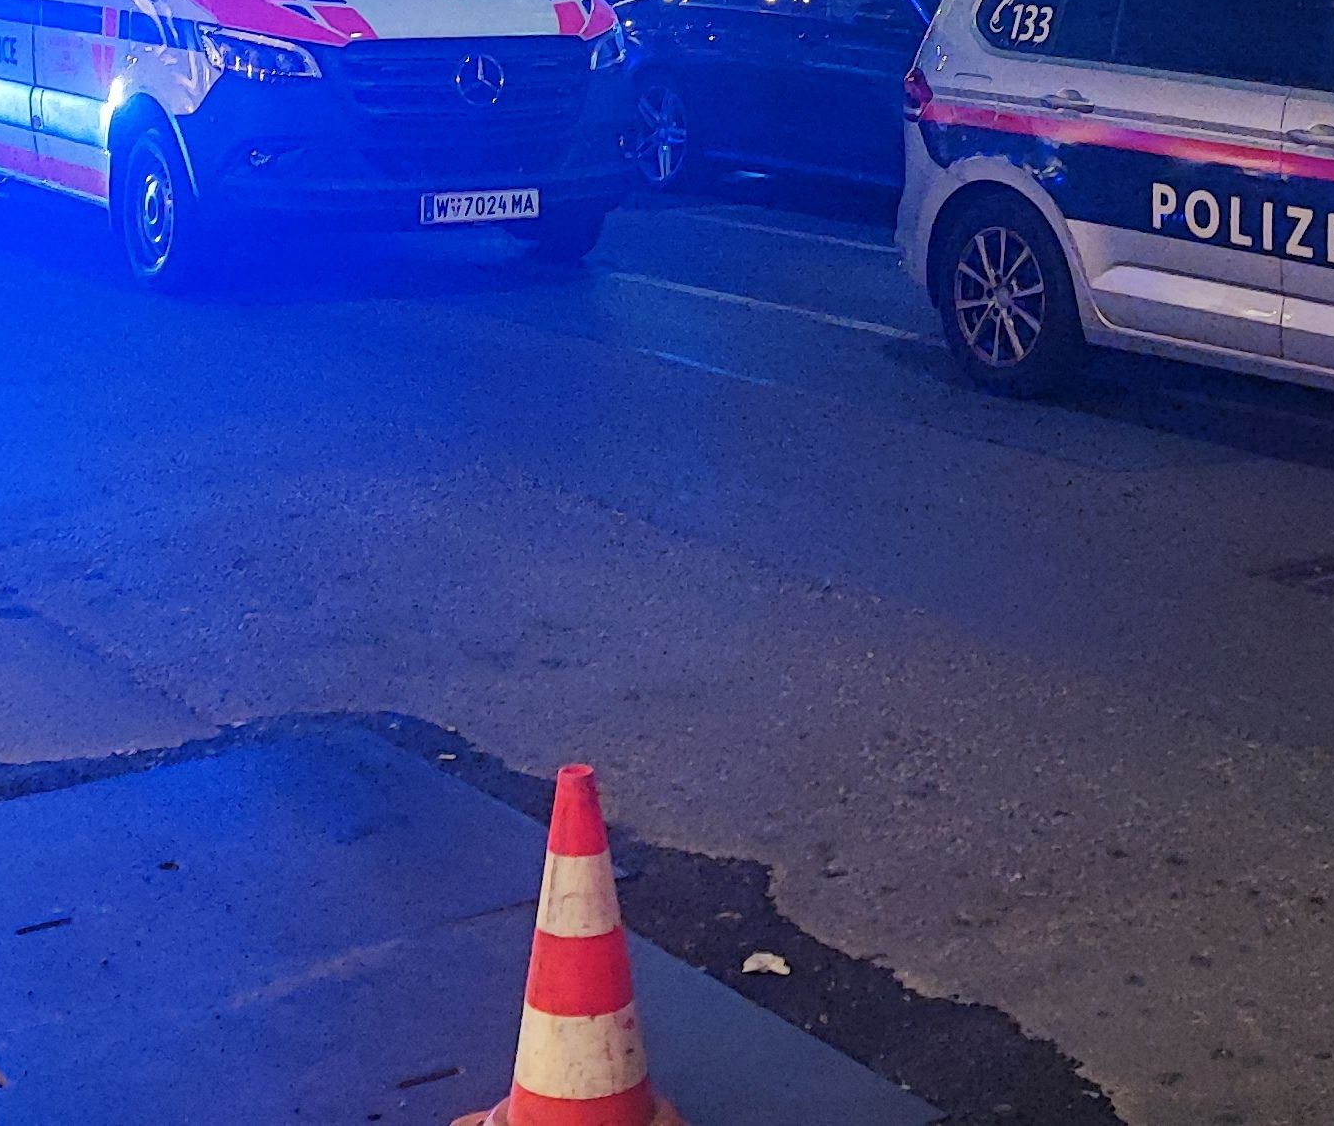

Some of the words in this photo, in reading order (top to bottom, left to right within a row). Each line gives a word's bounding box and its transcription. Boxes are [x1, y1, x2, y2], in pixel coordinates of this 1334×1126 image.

[1010, 3, 1054, 43] 133
[436, 197, 449, 218] W
[463, 195, 507, 217] 7024
[511, 193, 535, 214] MA
